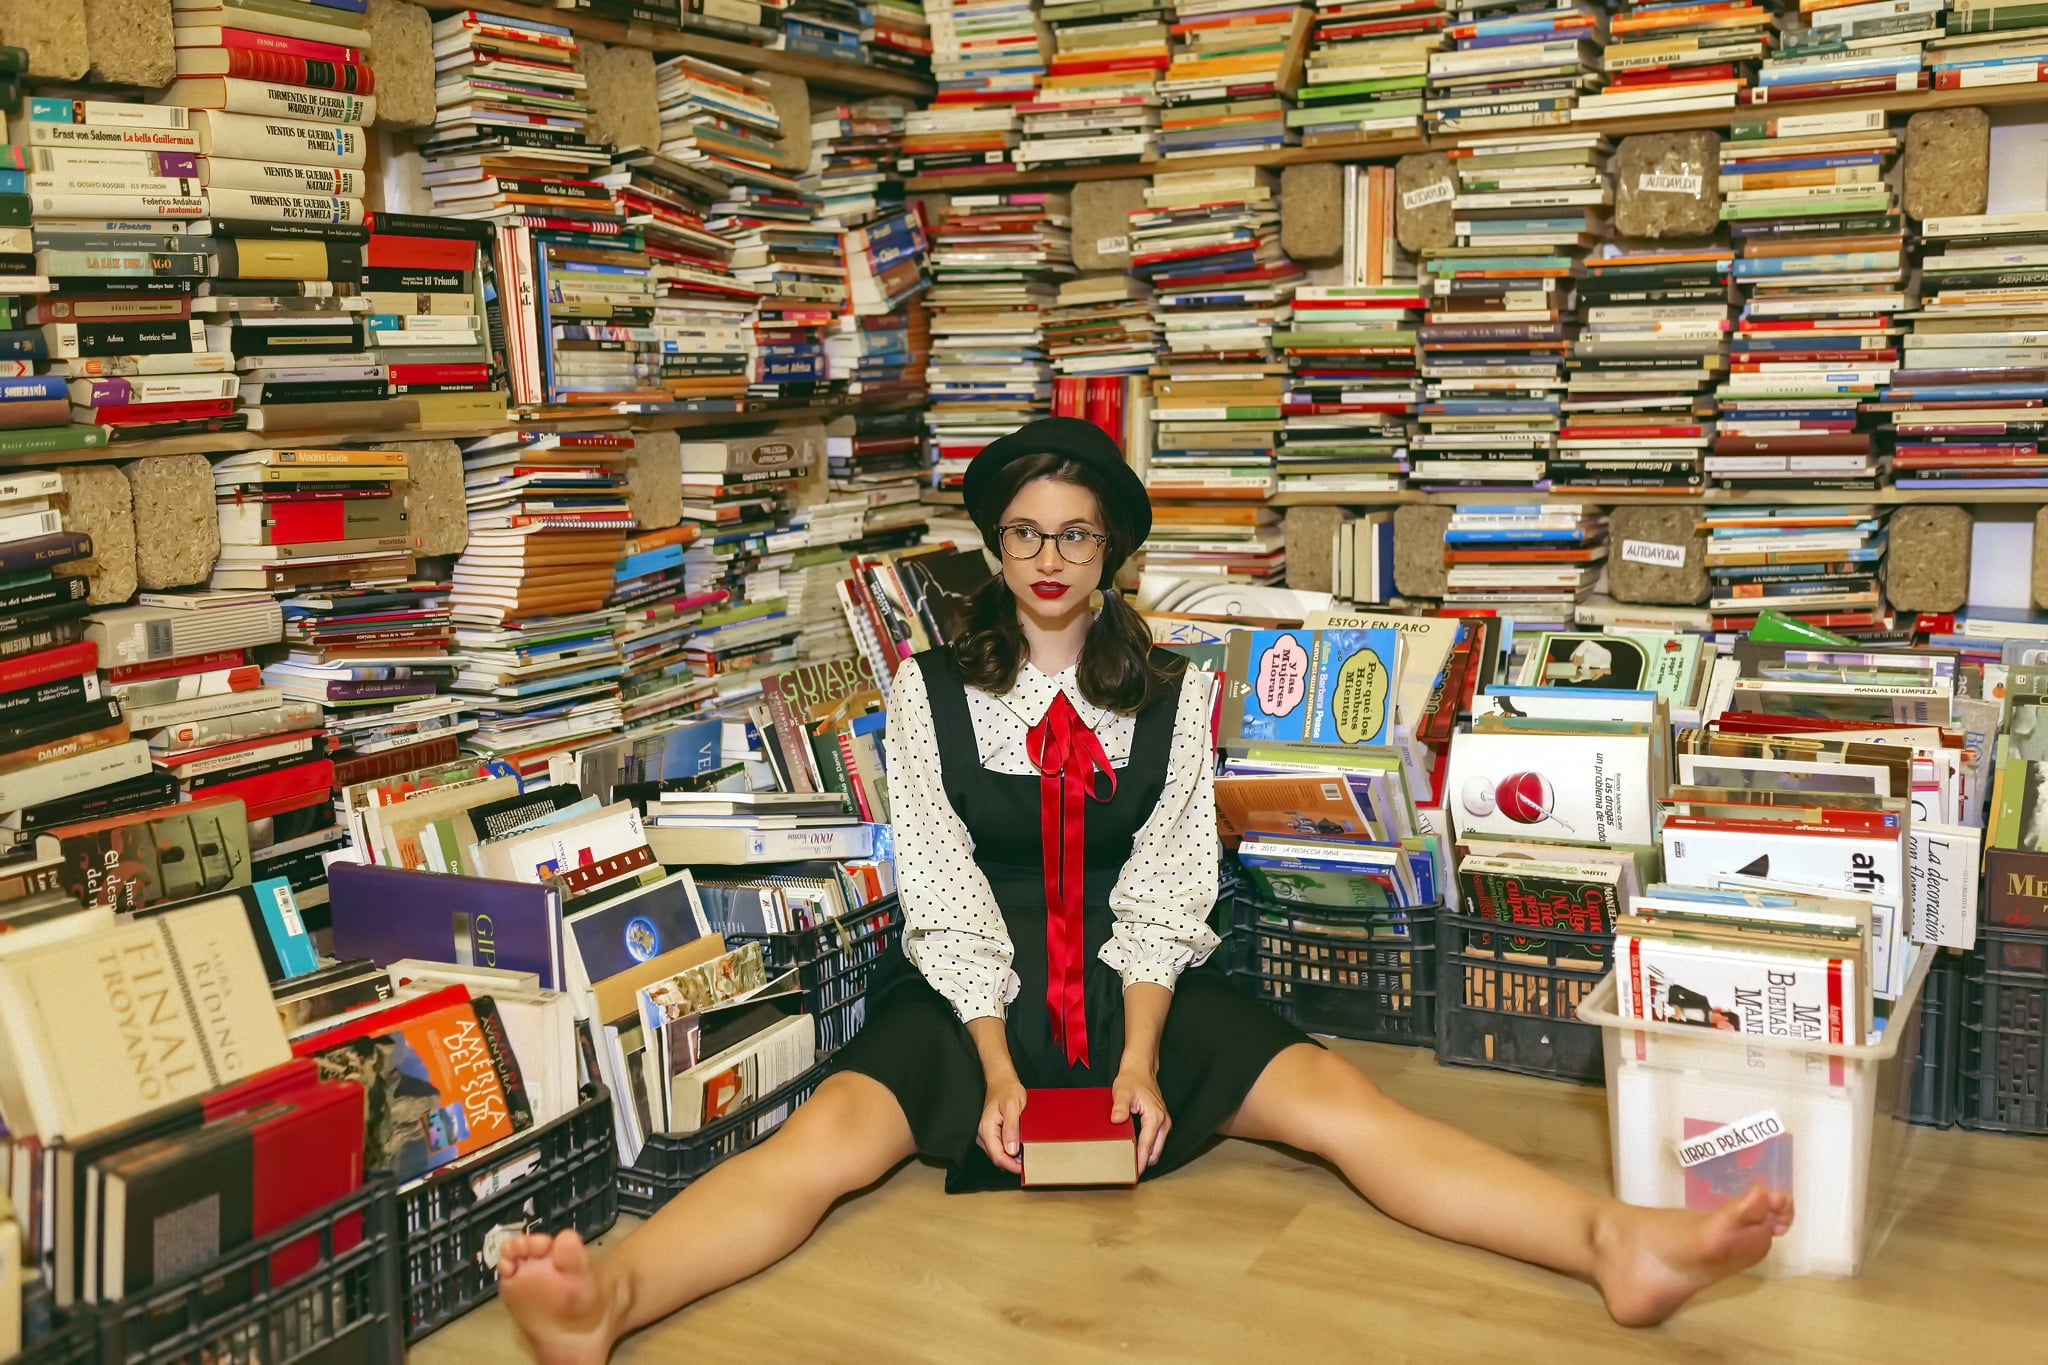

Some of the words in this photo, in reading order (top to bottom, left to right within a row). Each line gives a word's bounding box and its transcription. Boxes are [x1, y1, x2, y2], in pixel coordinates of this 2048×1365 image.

[267, 88, 308, 104] TORMENTAS
[308, 94, 318, 105] DE
[318, 94, 345, 108] GUERRA
[287, 102, 315, 116] WARREN
[316, 106, 322, 116] Y
[322, 106, 344, 119] JANICE
[1492, 106, 1498, 114] Y
[1500, 102, 1540, 113] PLEBEYOS
[52, 128, 74, 140] Ernst
[76, 131, 90, 141] von
[90, 130, 122, 142] Salomon
[123, 132, 133, 142] La
[134, 132, 151, 144] bella
[152, 134, 194, 146] Guillermina
[266, 126, 296, 138] VIENTOS
[296, 130, 306, 138] DE
[307, 130, 336, 142] GUERRA
[308, 140, 336, 152] PAMELA
[264, 166, 294, 178] VIENTOS
[294, 170, 304, 178] DE
[306, 170, 334, 181] GUERRA
[1646, 176, 1696, 190] AUTOAYUDA
[306, 180, 334, 192] NATALIE
[142, 197, 171, 206] Federico
[158, 206, 165, 214] El
[166, 206, 202, 214] anatomista
[250, 195, 292, 208] TORMENTAS
[293, 198, 302, 208] DE
[303, 198, 331, 210] GUERRA
[282, 208, 298, 218] PUG
[299, 208, 304, 218] Y
[304, 208, 331, 220] PAMELA
[86, 256, 100, 269] LA
[123, 257, 144, 269] DEL
[424, 276, 432, 286] El
[434, 275, 458, 286] Triunfo
[139, 334, 160, 342] Bertrice
[161, 332, 177, 342] Small
[300, 452, 326, 463] Madrid
[326, 453, 349, 464] Guide
[1626, 546, 1680, 561] AUTOAYUDA
[1327, 618, 1368, 629] ESTOY
[1370, 620, 1390, 630] EN
[1392, 622, 1432, 634] PARO
[1288, 661, 1297, 670] y
[1366, 662, 1376, 688] Por
[1268, 652, 1280, 702] Lloran
[1276, 648, 1290, 708] Mujeres
[1288, 673, 1298, 694] las
[1232, 681, 1240, 698] Amat
[1316, 674, 1328, 708] Barbara
[1340, 672, 1354, 726] Mienten
[1351, 667, 1366, 730] Hombres
[1854, 686, 1887, 695] MANUAL
[1890, 688, 1900, 696] DE
[1901, 687, 1938, 696] LIMPIEZA
[1363, 689, 1373, 714] qué
[1304, 694, 1314, 738] INTERNACIONAL
[1312, 710, 1324, 738] Pease
[1361, 716, 1372, 736] los
[38, 743, 78, 762] DAMON
[832, 751, 843, 773] Daniel
[1596, 752, 1604, 763] un
[1595, 766, 1604, 810] problema
[1604, 777, 1614, 793] Las
[1597, 811, 1604, 822] de
[1604, 794, 1614, 826] drogas
[1598, 823, 1606, 842] todo
[104, 850, 120, 870] El
[1260, 844, 1278, 853] 2012
[1282, 846, 1290, 854] LA
[1322, 848, 1340, 857] MAYA
[1930, 838, 1950, 865] La
[566, 850, 646, 886] ZAMORA
[1580, 869, 1608, 878] SMITH
[86, 868, 103, 894] del
[1926, 869, 1948, 942] decoración
[2004, 908, 2032, 926] de
[208, 942, 232, 998] LAURA
[1768, 970, 1796, 1038] BUENAS
[98, 950, 162, 1100] TROYANO
[123, 942, 196, 1092] FINAL
[192, 962, 240, 1070] RIDING
[481, 1016, 512, 1095] AVENTURA
[443, 1033, 473, 1076] DEL
[460, 1080, 487, 1127] SUR
[456, 1020, 506, 1130] AMÉRICA
[1679, 1141, 1716, 1164] LIBRO
[1716, 1117, 1780, 1156] PRÁCTICO
